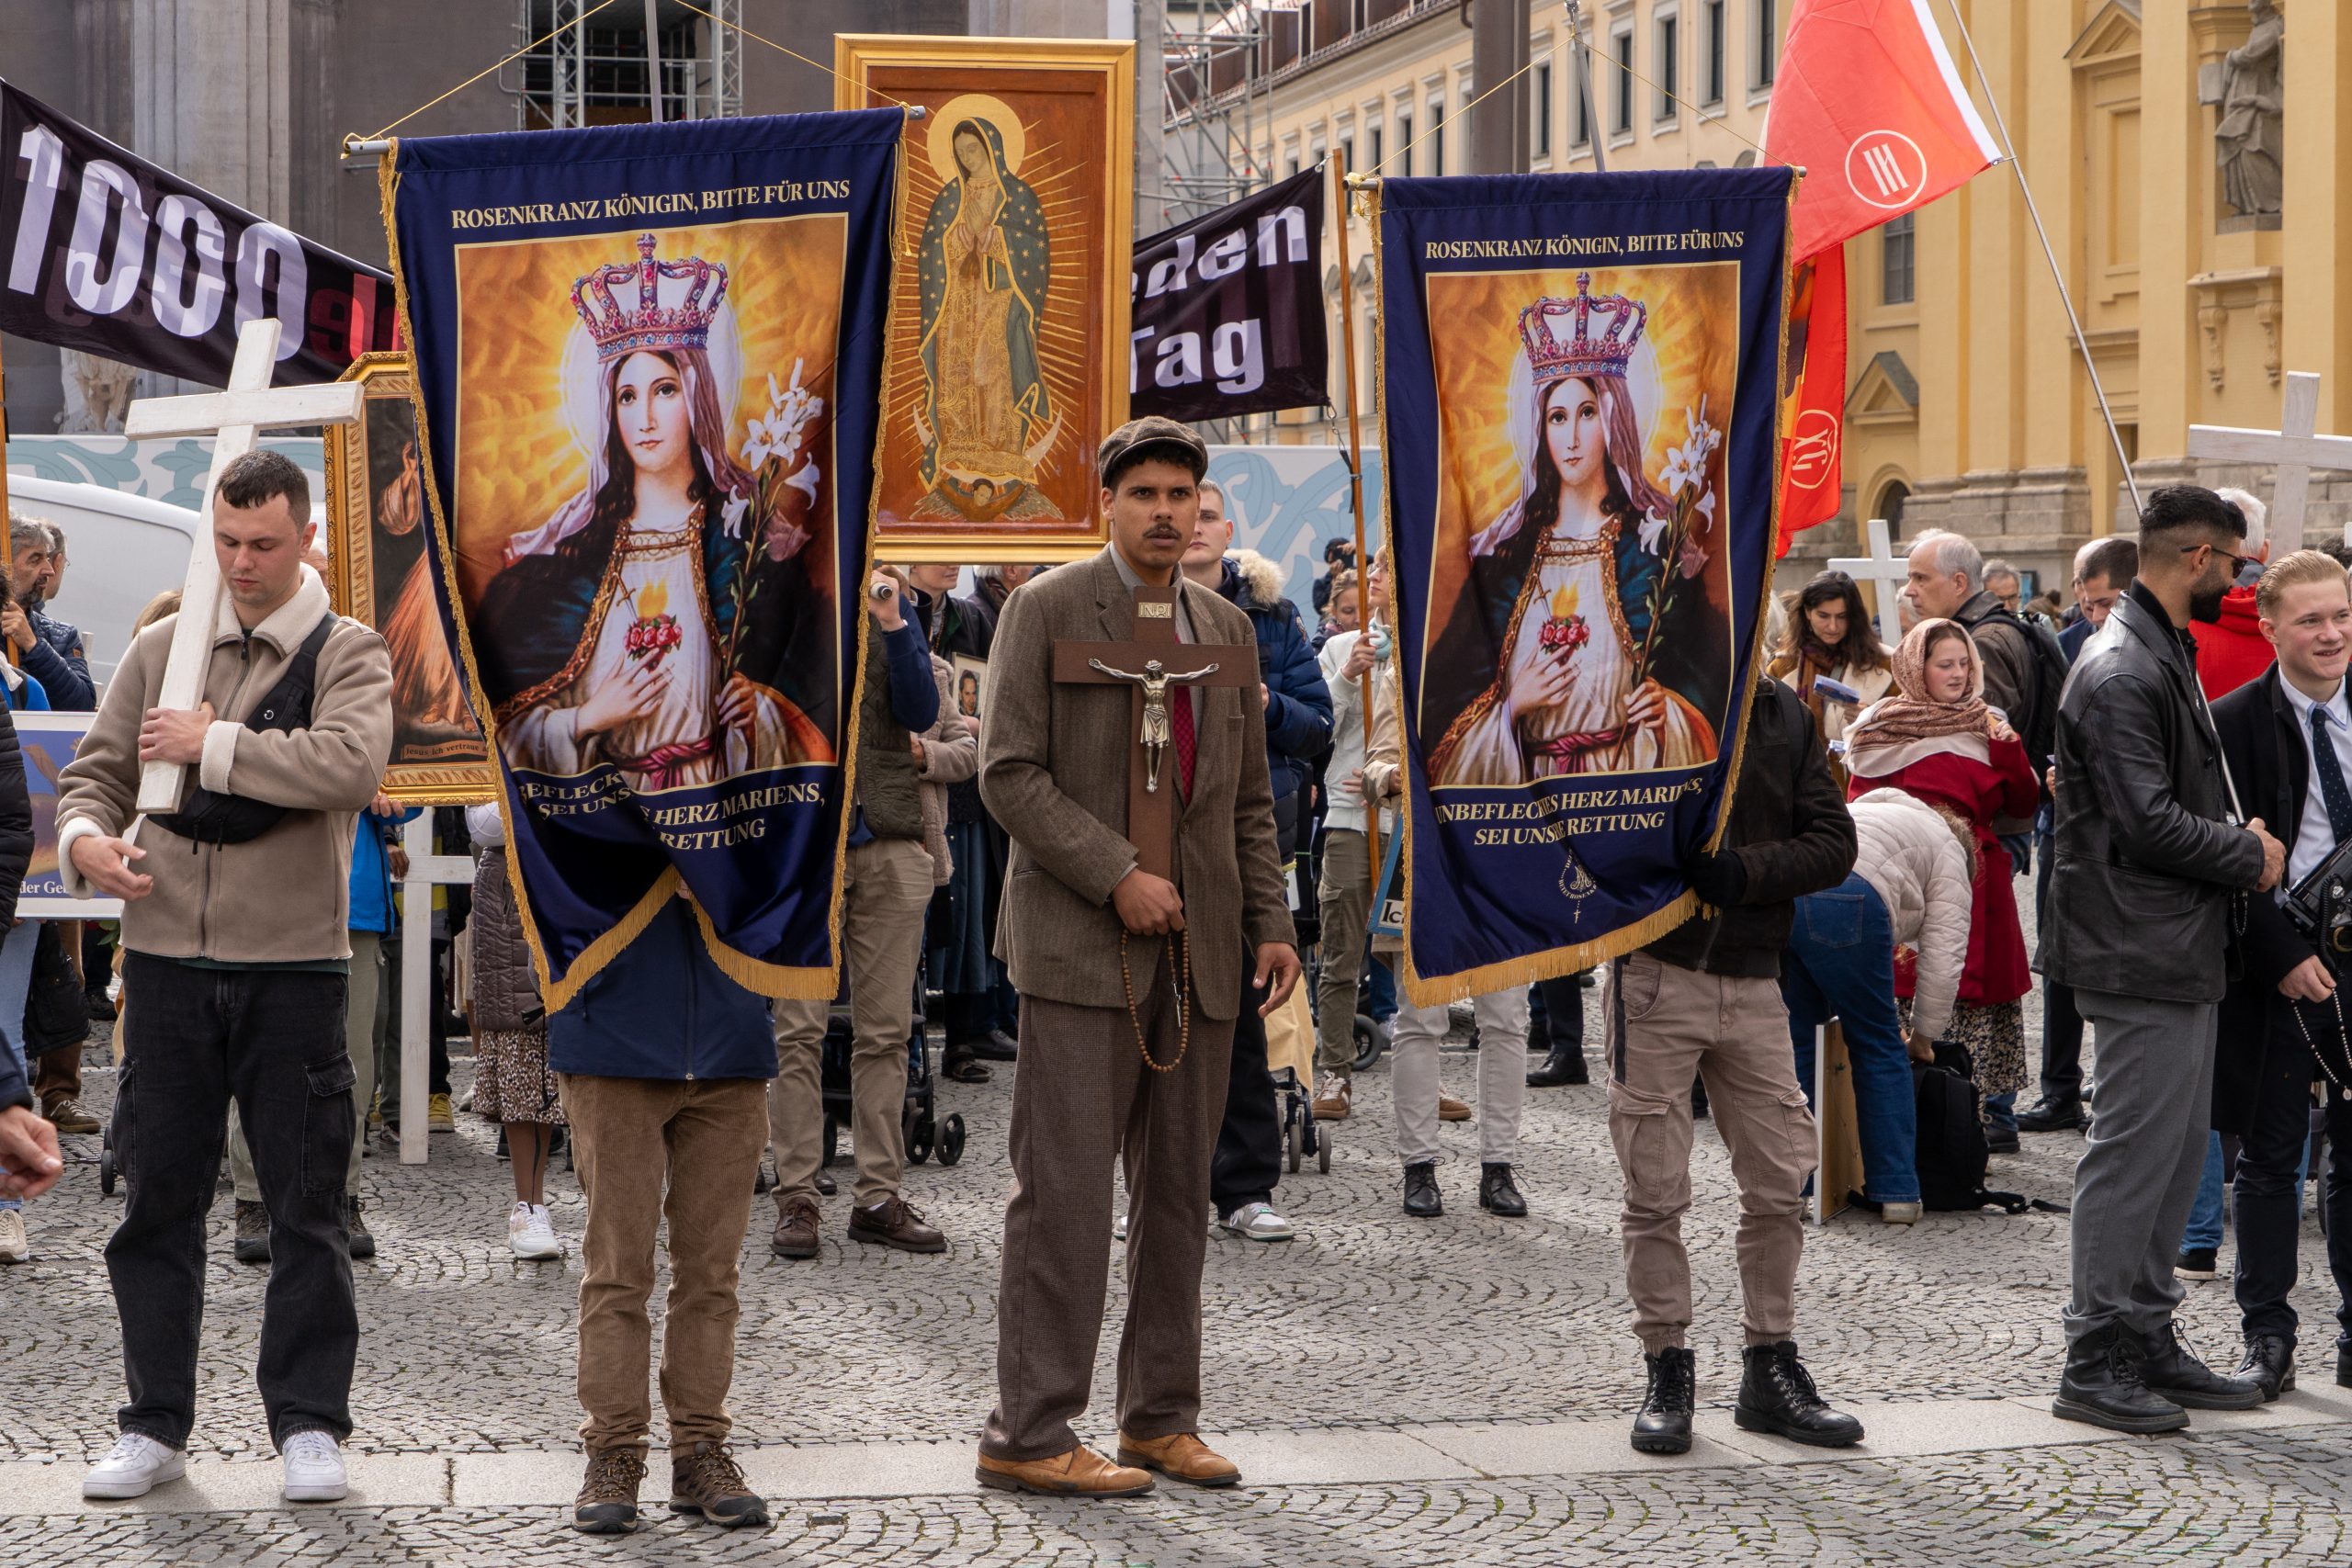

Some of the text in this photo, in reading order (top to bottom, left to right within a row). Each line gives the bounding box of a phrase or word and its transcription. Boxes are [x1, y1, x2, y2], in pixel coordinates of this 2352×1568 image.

[451, 179, 851, 229] ROSENKRANZ KÖNIGIN, BITTE FÜR UNS
[7, 123, 308, 361] 1000
[1426, 229, 1744, 259] ROSENKRANZ KÖNIGIN, BITTE FÜR UNS
[1140, 604, 1170, 616] INRI
[654, 802, 719, 826] HERZ
[721, 782, 825, 818] MARIENS,
[1561, 789, 1618, 810] HERZ
[538, 803, 578, 820] SEI
[660, 818, 766, 850] RETTUNG
[1474, 829, 1510, 845] SEI
[1567, 811, 1666, 836] RETTUNG
[43, 880, 67, 894] Ge
[1382, 901, 1405, 924] Ic
